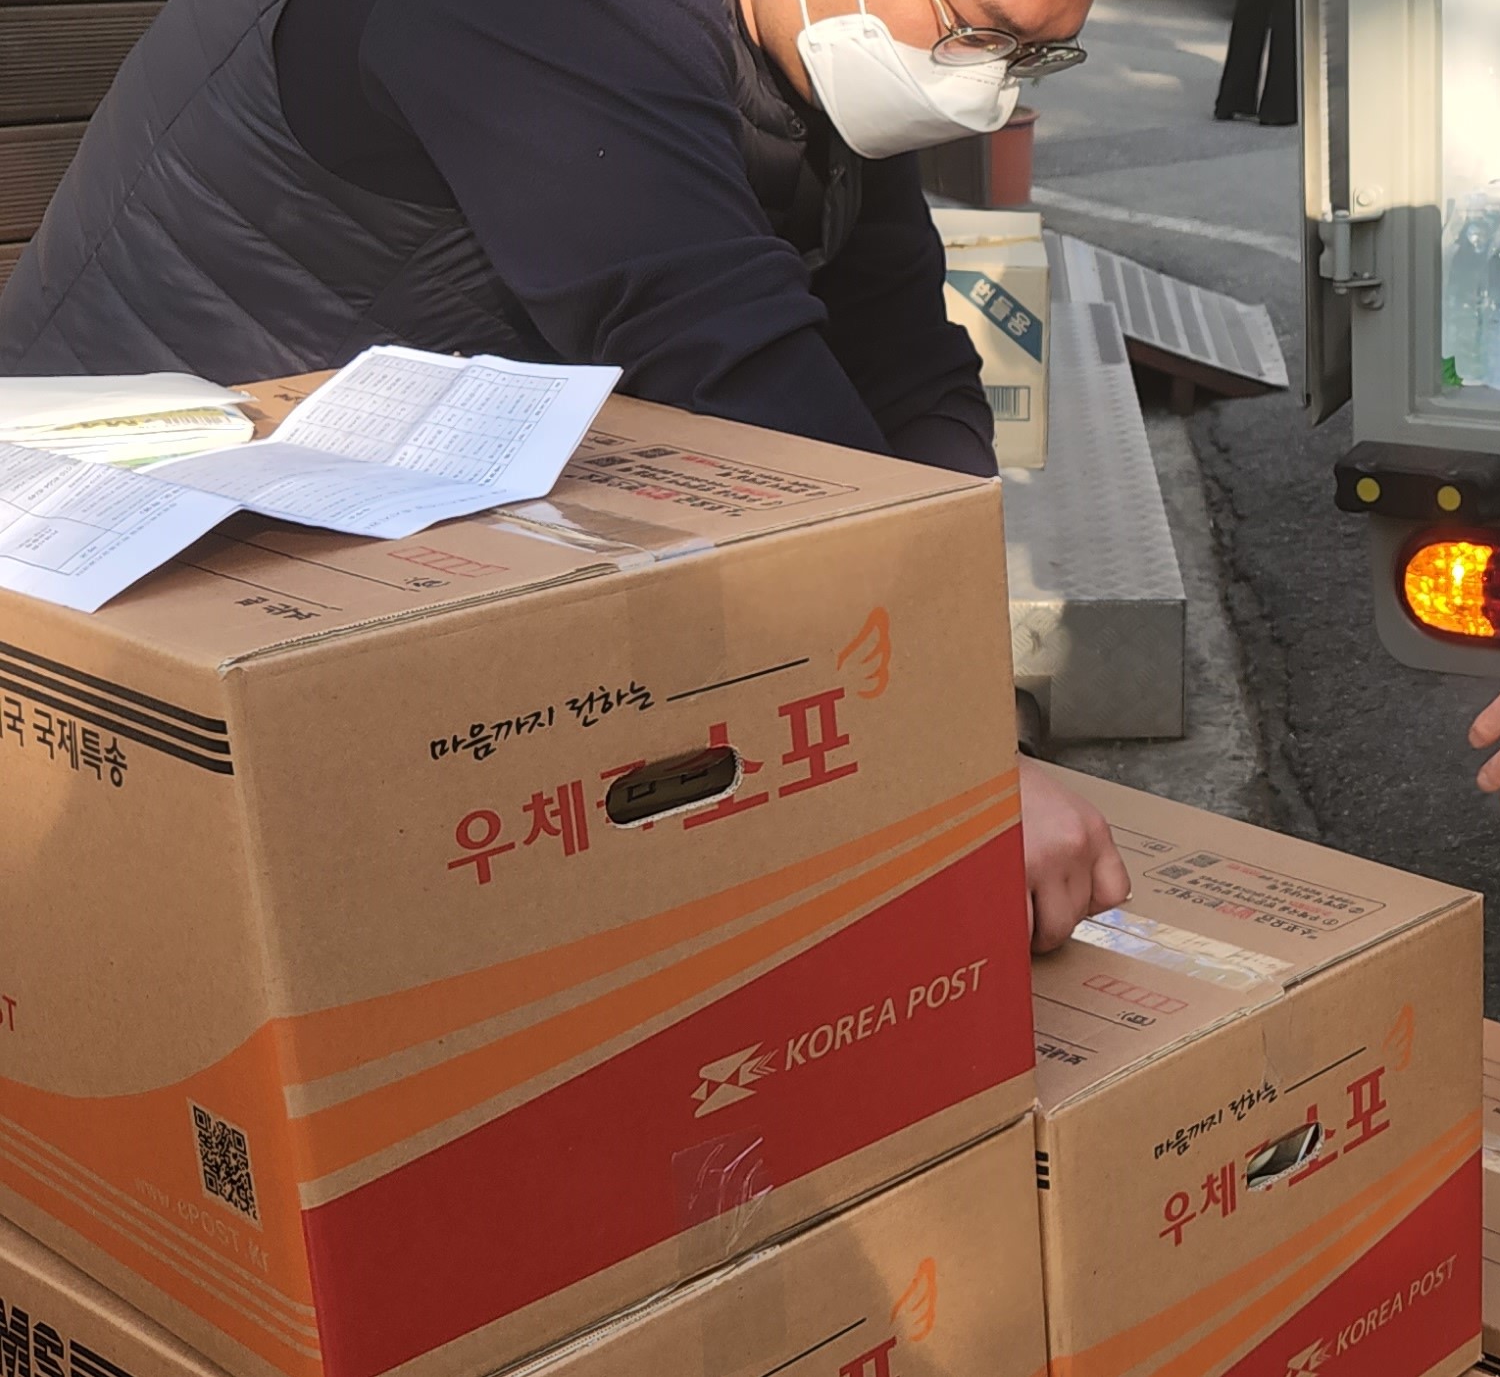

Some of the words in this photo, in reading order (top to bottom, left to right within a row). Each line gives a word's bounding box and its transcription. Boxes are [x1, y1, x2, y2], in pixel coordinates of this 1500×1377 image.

[0, 694, 25, 747] 국
[32, 707, 129, 789] 국제특송
[430, 705, 555, 762] 마음까지
[783, 997, 899, 1073] KOREA
[905, 957, 990, 1021] POST
[1152, 1107, 1224, 1160] 마음까지
[1336, 1291, 1405, 1356] KOREA
[1408, 1254, 1458, 1301] POST
